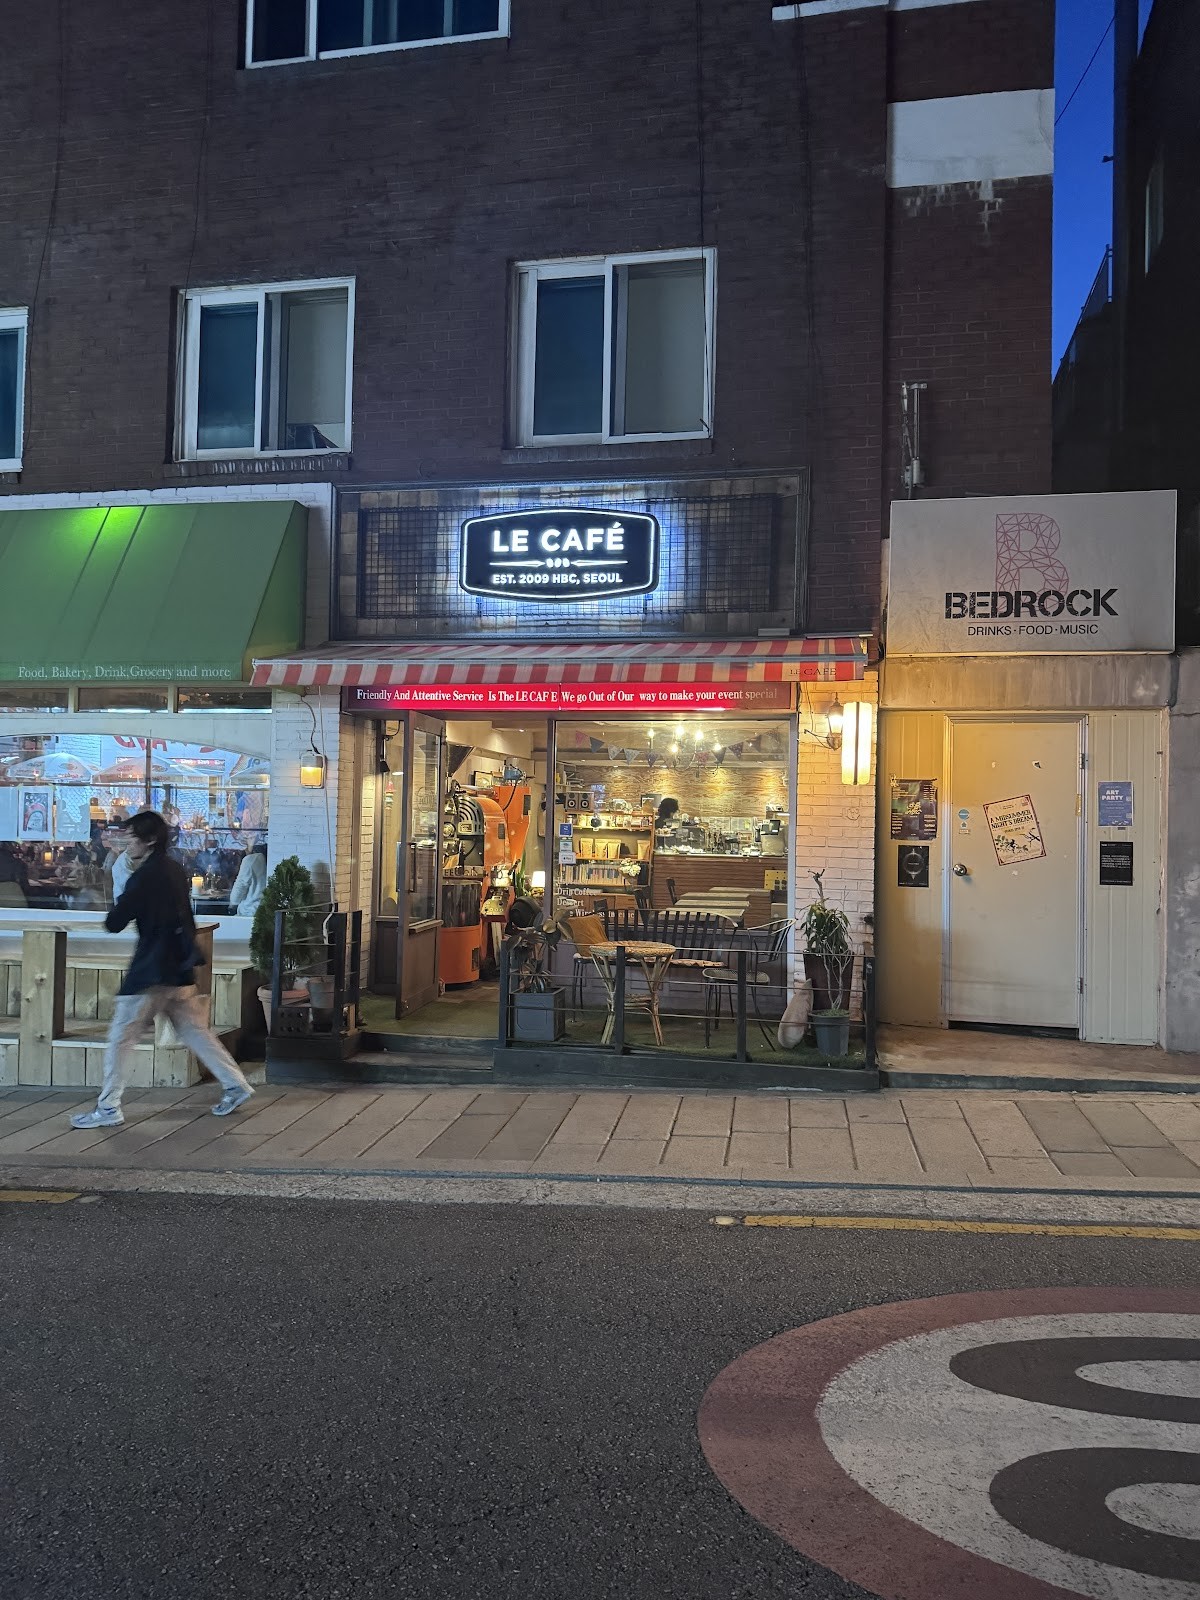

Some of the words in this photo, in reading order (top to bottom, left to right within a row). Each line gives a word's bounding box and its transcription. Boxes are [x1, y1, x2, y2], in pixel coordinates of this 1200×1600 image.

[492, 529, 529, 552] LE
[540, 521, 625, 552] CAFÉ
[492, 573, 517, 584] EST.
[519, 573, 550, 584] 2009
[552, 573, 580, 585] HBC,
[583, 572, 623, 583] SEOUL
[944, 588, 1119, 619] BEDROCK
[967, 625, 1012, 636] DRINKS
[1018, 625, 1053, 635] FOOD
[1059, 623, 1099, 635] MUSIC
[18, 666, 48, 678] Food,
[51, 666, 92, 680] Bakery,
[176, 665, 197, 677] and
[201, 667, 231, 677] more
[356, 689, 392, 701] Friendly
[393, 690, 410, 700] And
[411, 690, 451, 701] Attentive
[452, 690, 484, 702] Service
[488, 691, 497, 702] Is
[498, 690, 514, 702] The
[561, 691, 575, 702] We
[576, 693, 587, 704] go
[588, 691, 604, 702] Out
[606, 690, 616, 702] of
[617, 691, 634, 702] Our
[639, 692, 656, 702] way
[658, 690, 668, 701] to
[669, 690, 694, 700] make
[695, 690, 716, 701] your
[717, 690, 743, 700] event
[745, 688, 777, 701] special
